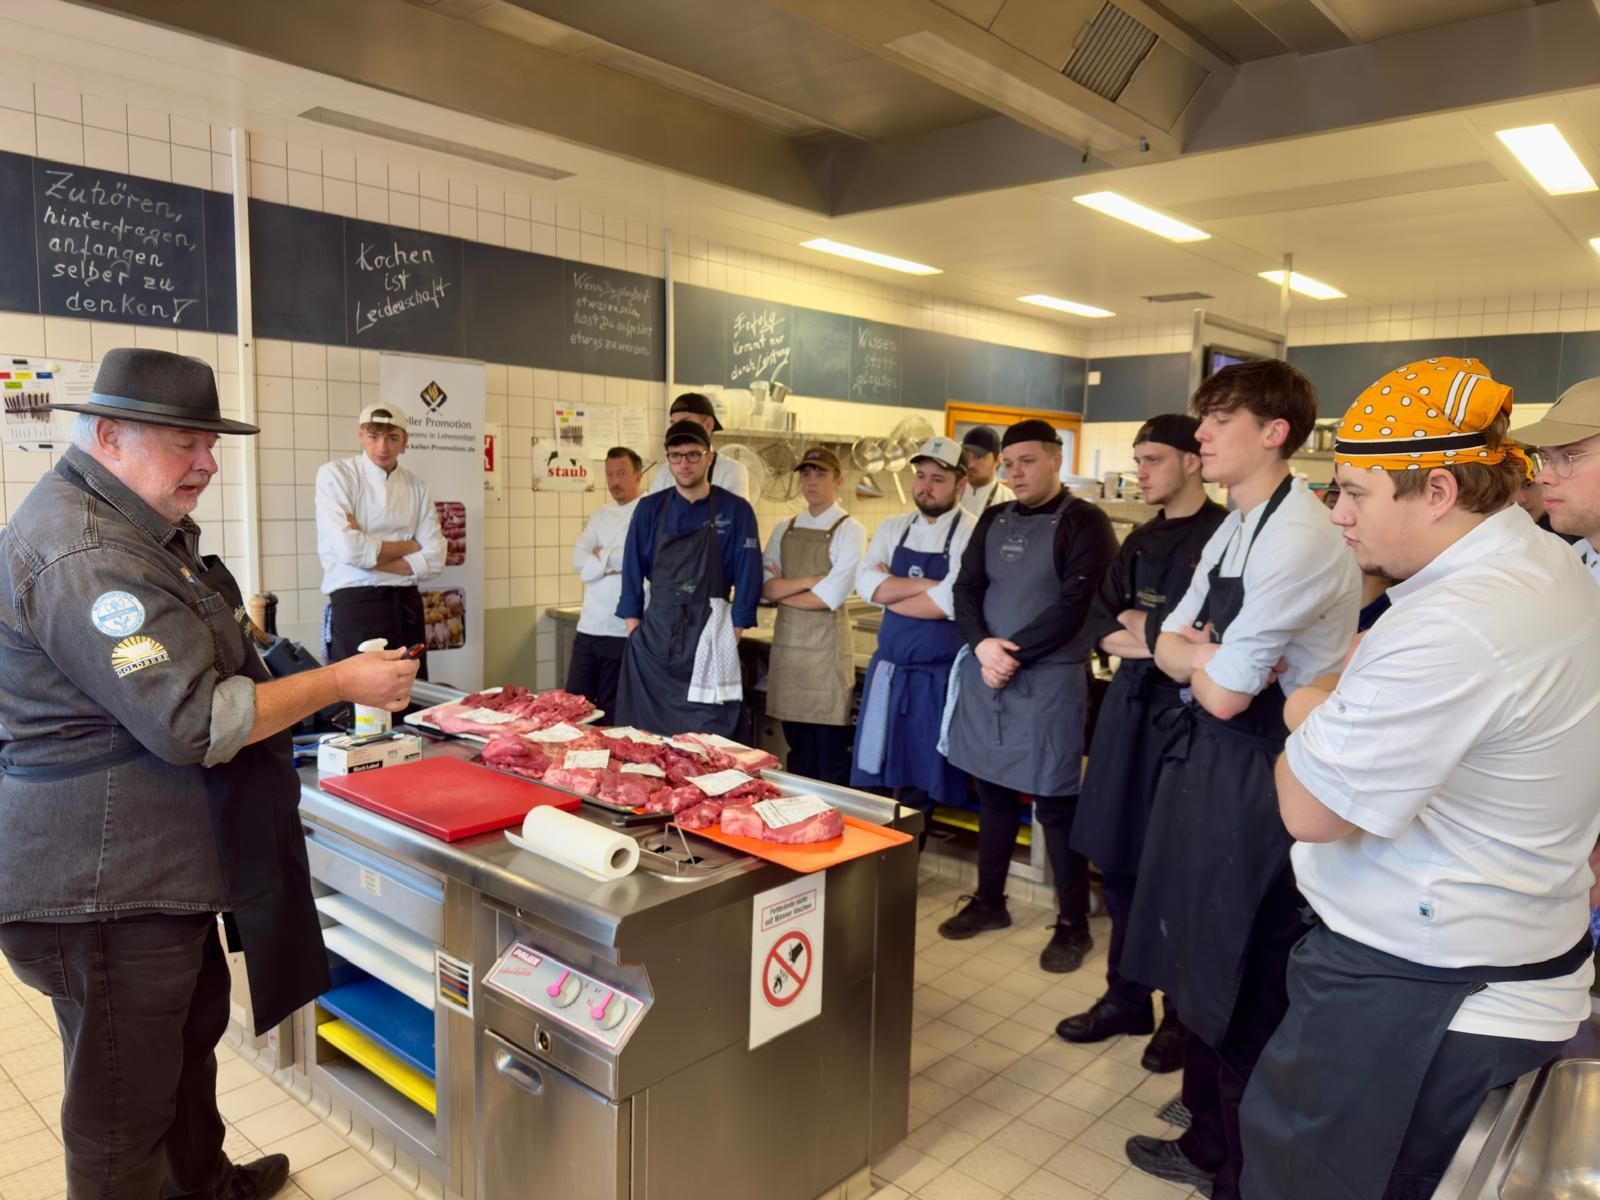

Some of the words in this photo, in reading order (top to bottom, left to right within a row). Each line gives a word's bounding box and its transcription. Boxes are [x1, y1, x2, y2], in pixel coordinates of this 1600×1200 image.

[45, 170, 183, 223] Zuhören,
[49, 235, 164, 272] anfangen
[355, 242, 434, 271] Kochen
[52, 260, 129, 287] selber
[143, 276, 175, 292] zu
[384, 269, 411, 292] ist
[356, 277, 451, 334] Leidenschaft
[425, 417, 472, 429] Promotion
[547, 465, 587, 478] staub
